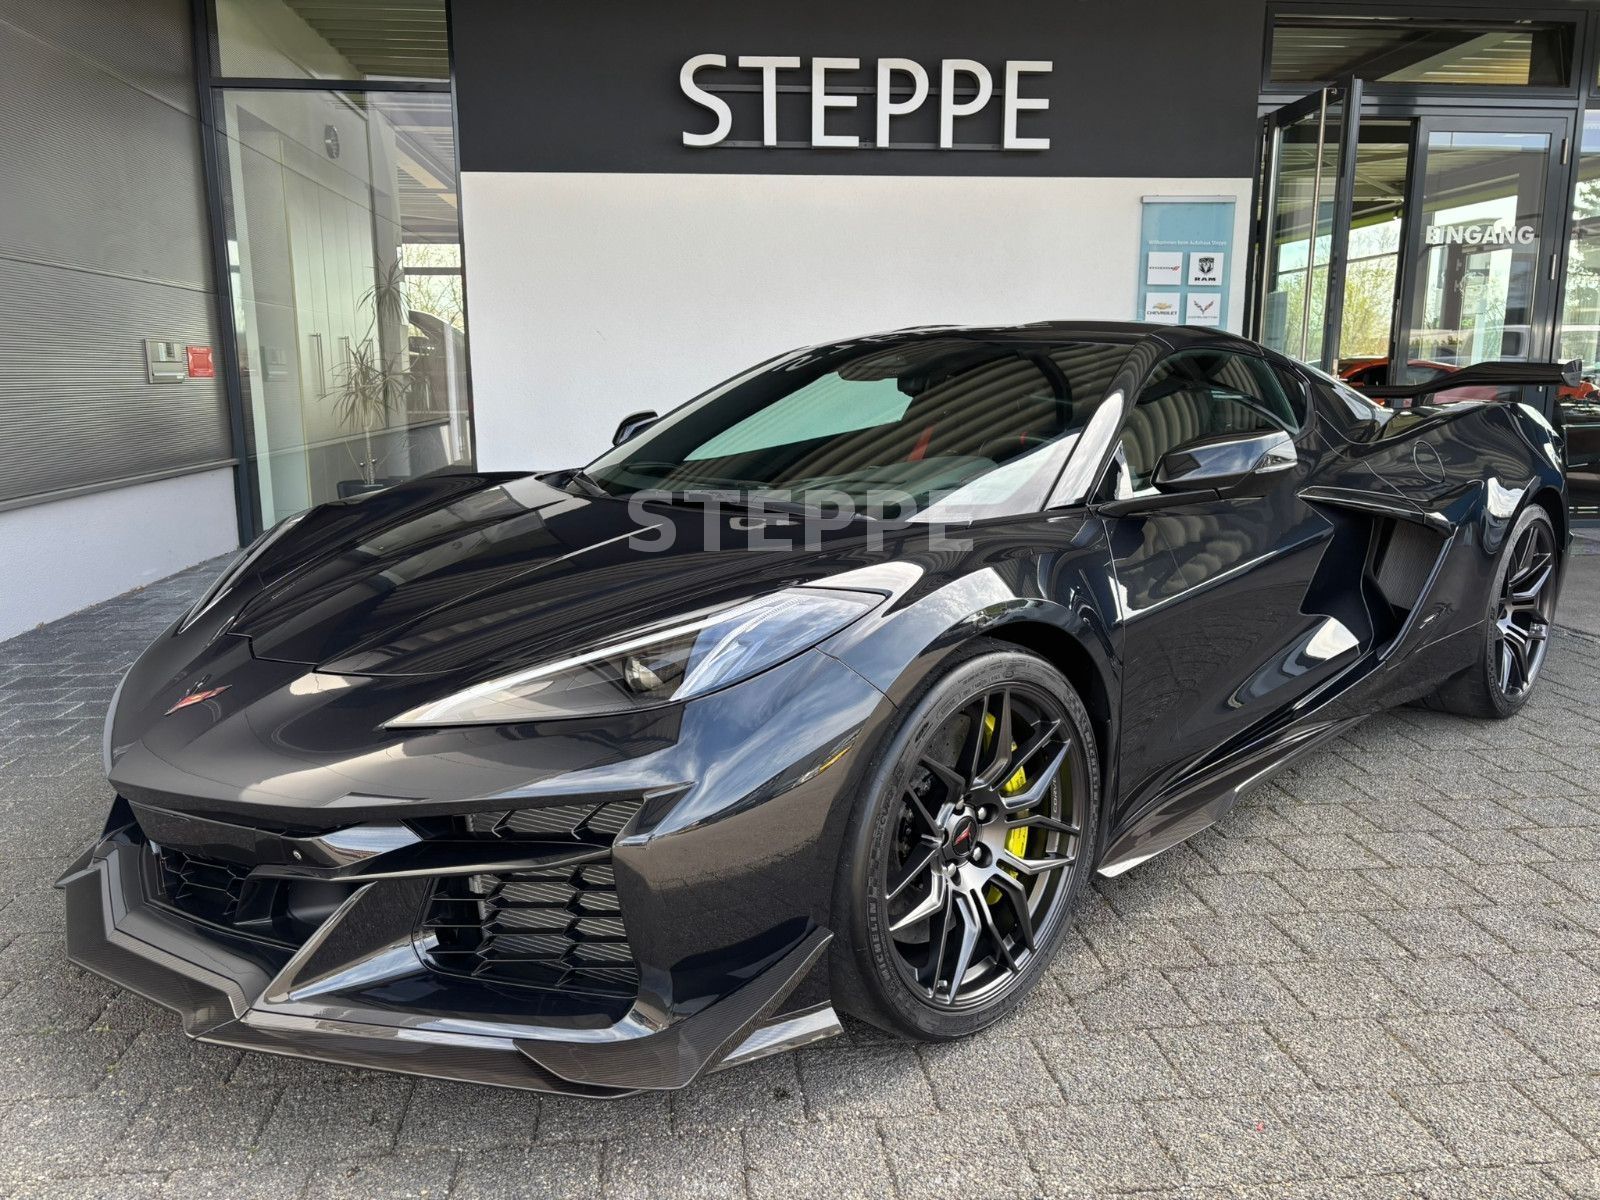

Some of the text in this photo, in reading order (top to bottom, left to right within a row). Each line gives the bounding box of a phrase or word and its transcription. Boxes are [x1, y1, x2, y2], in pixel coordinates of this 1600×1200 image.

[679, 53, 1053, 150] STEPPE
[1425, 225, 1535, 245] EINGANG
[869, 902, 891, 981] MICHELIN
